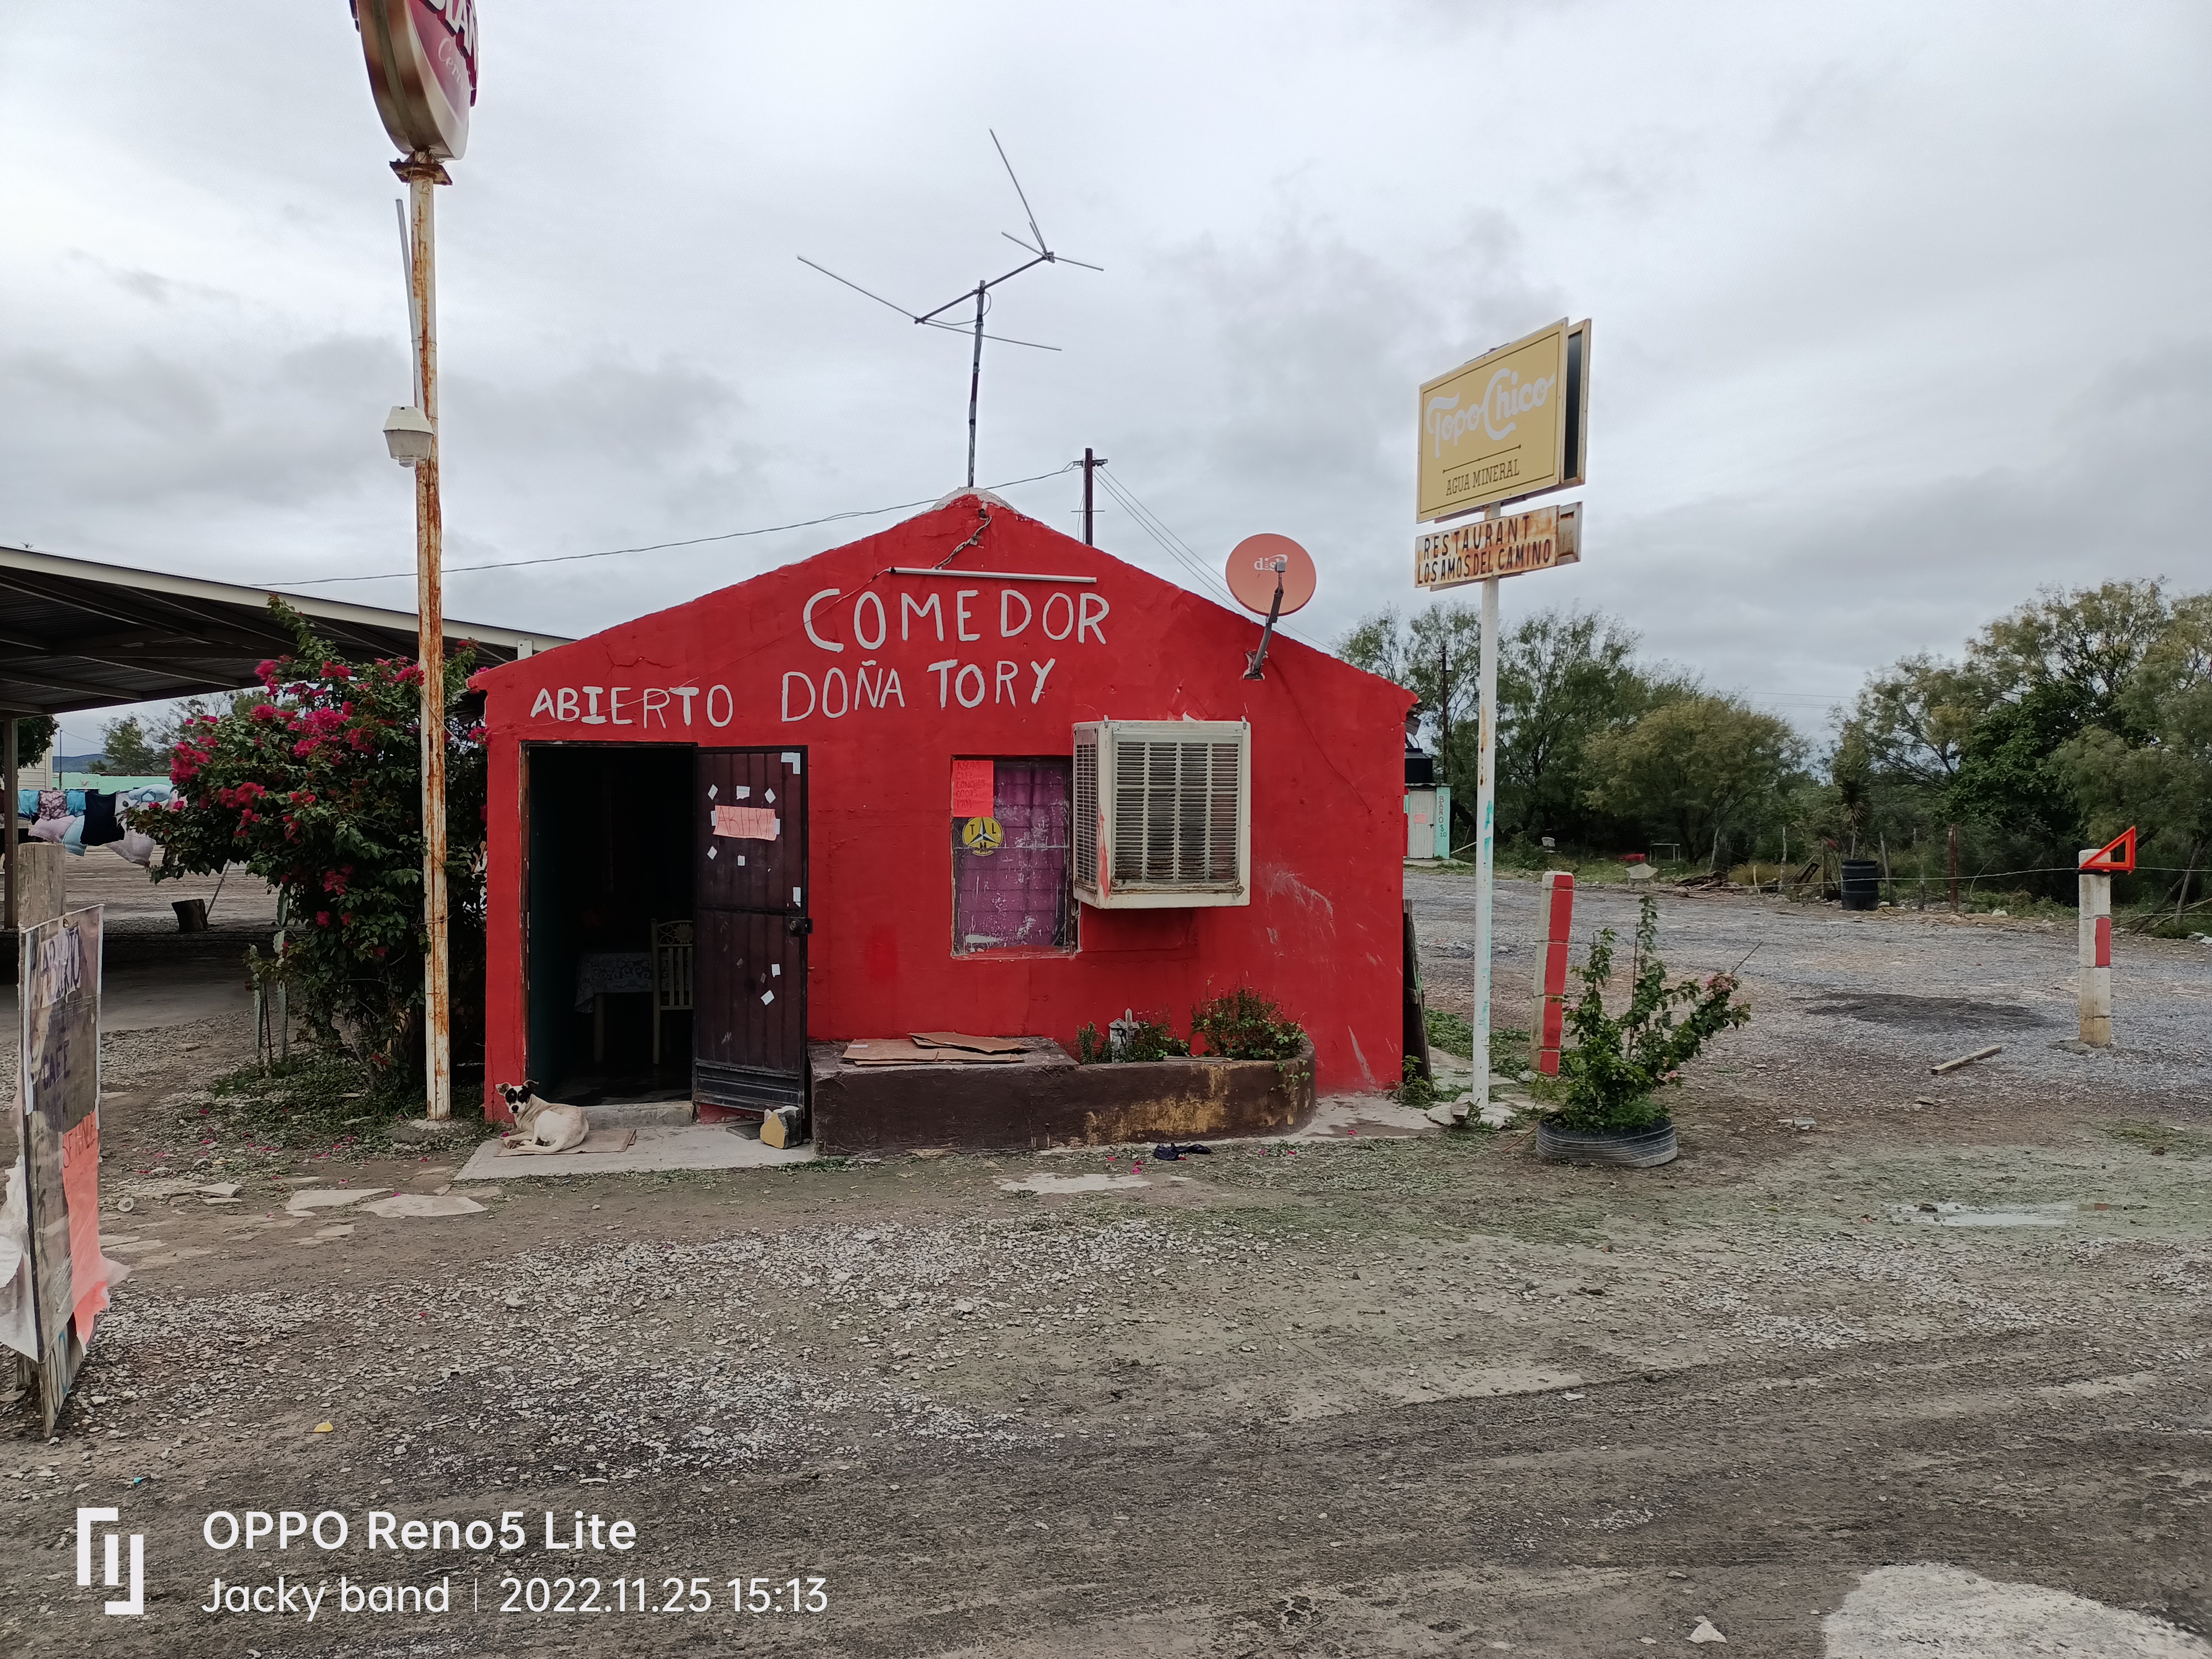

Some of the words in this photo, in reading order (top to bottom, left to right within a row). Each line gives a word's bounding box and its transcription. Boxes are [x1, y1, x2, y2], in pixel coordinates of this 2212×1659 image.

[1426, 392, 1482, 458] Topo
[1483, 368, 1556, 441] Chico
[1446, 473, 1470, 497] AGUA
[1472, 458, 1520, 488] MINERAL
[1423, 515, 1530, 561] RESTAURANT
[1498, 538, 1551, 571] CAMINO
[803, 589, 1109, 653] COMEDOR
[530, 684, 733, 729] ABIERTO
[781, 660, 905, 722] DOÑA
[926, 658, 1056, 708] TORY
[957, 799, 972, 808] PAN
[969, 824, 975, 836] T
[992, 822, 997, 834] L
